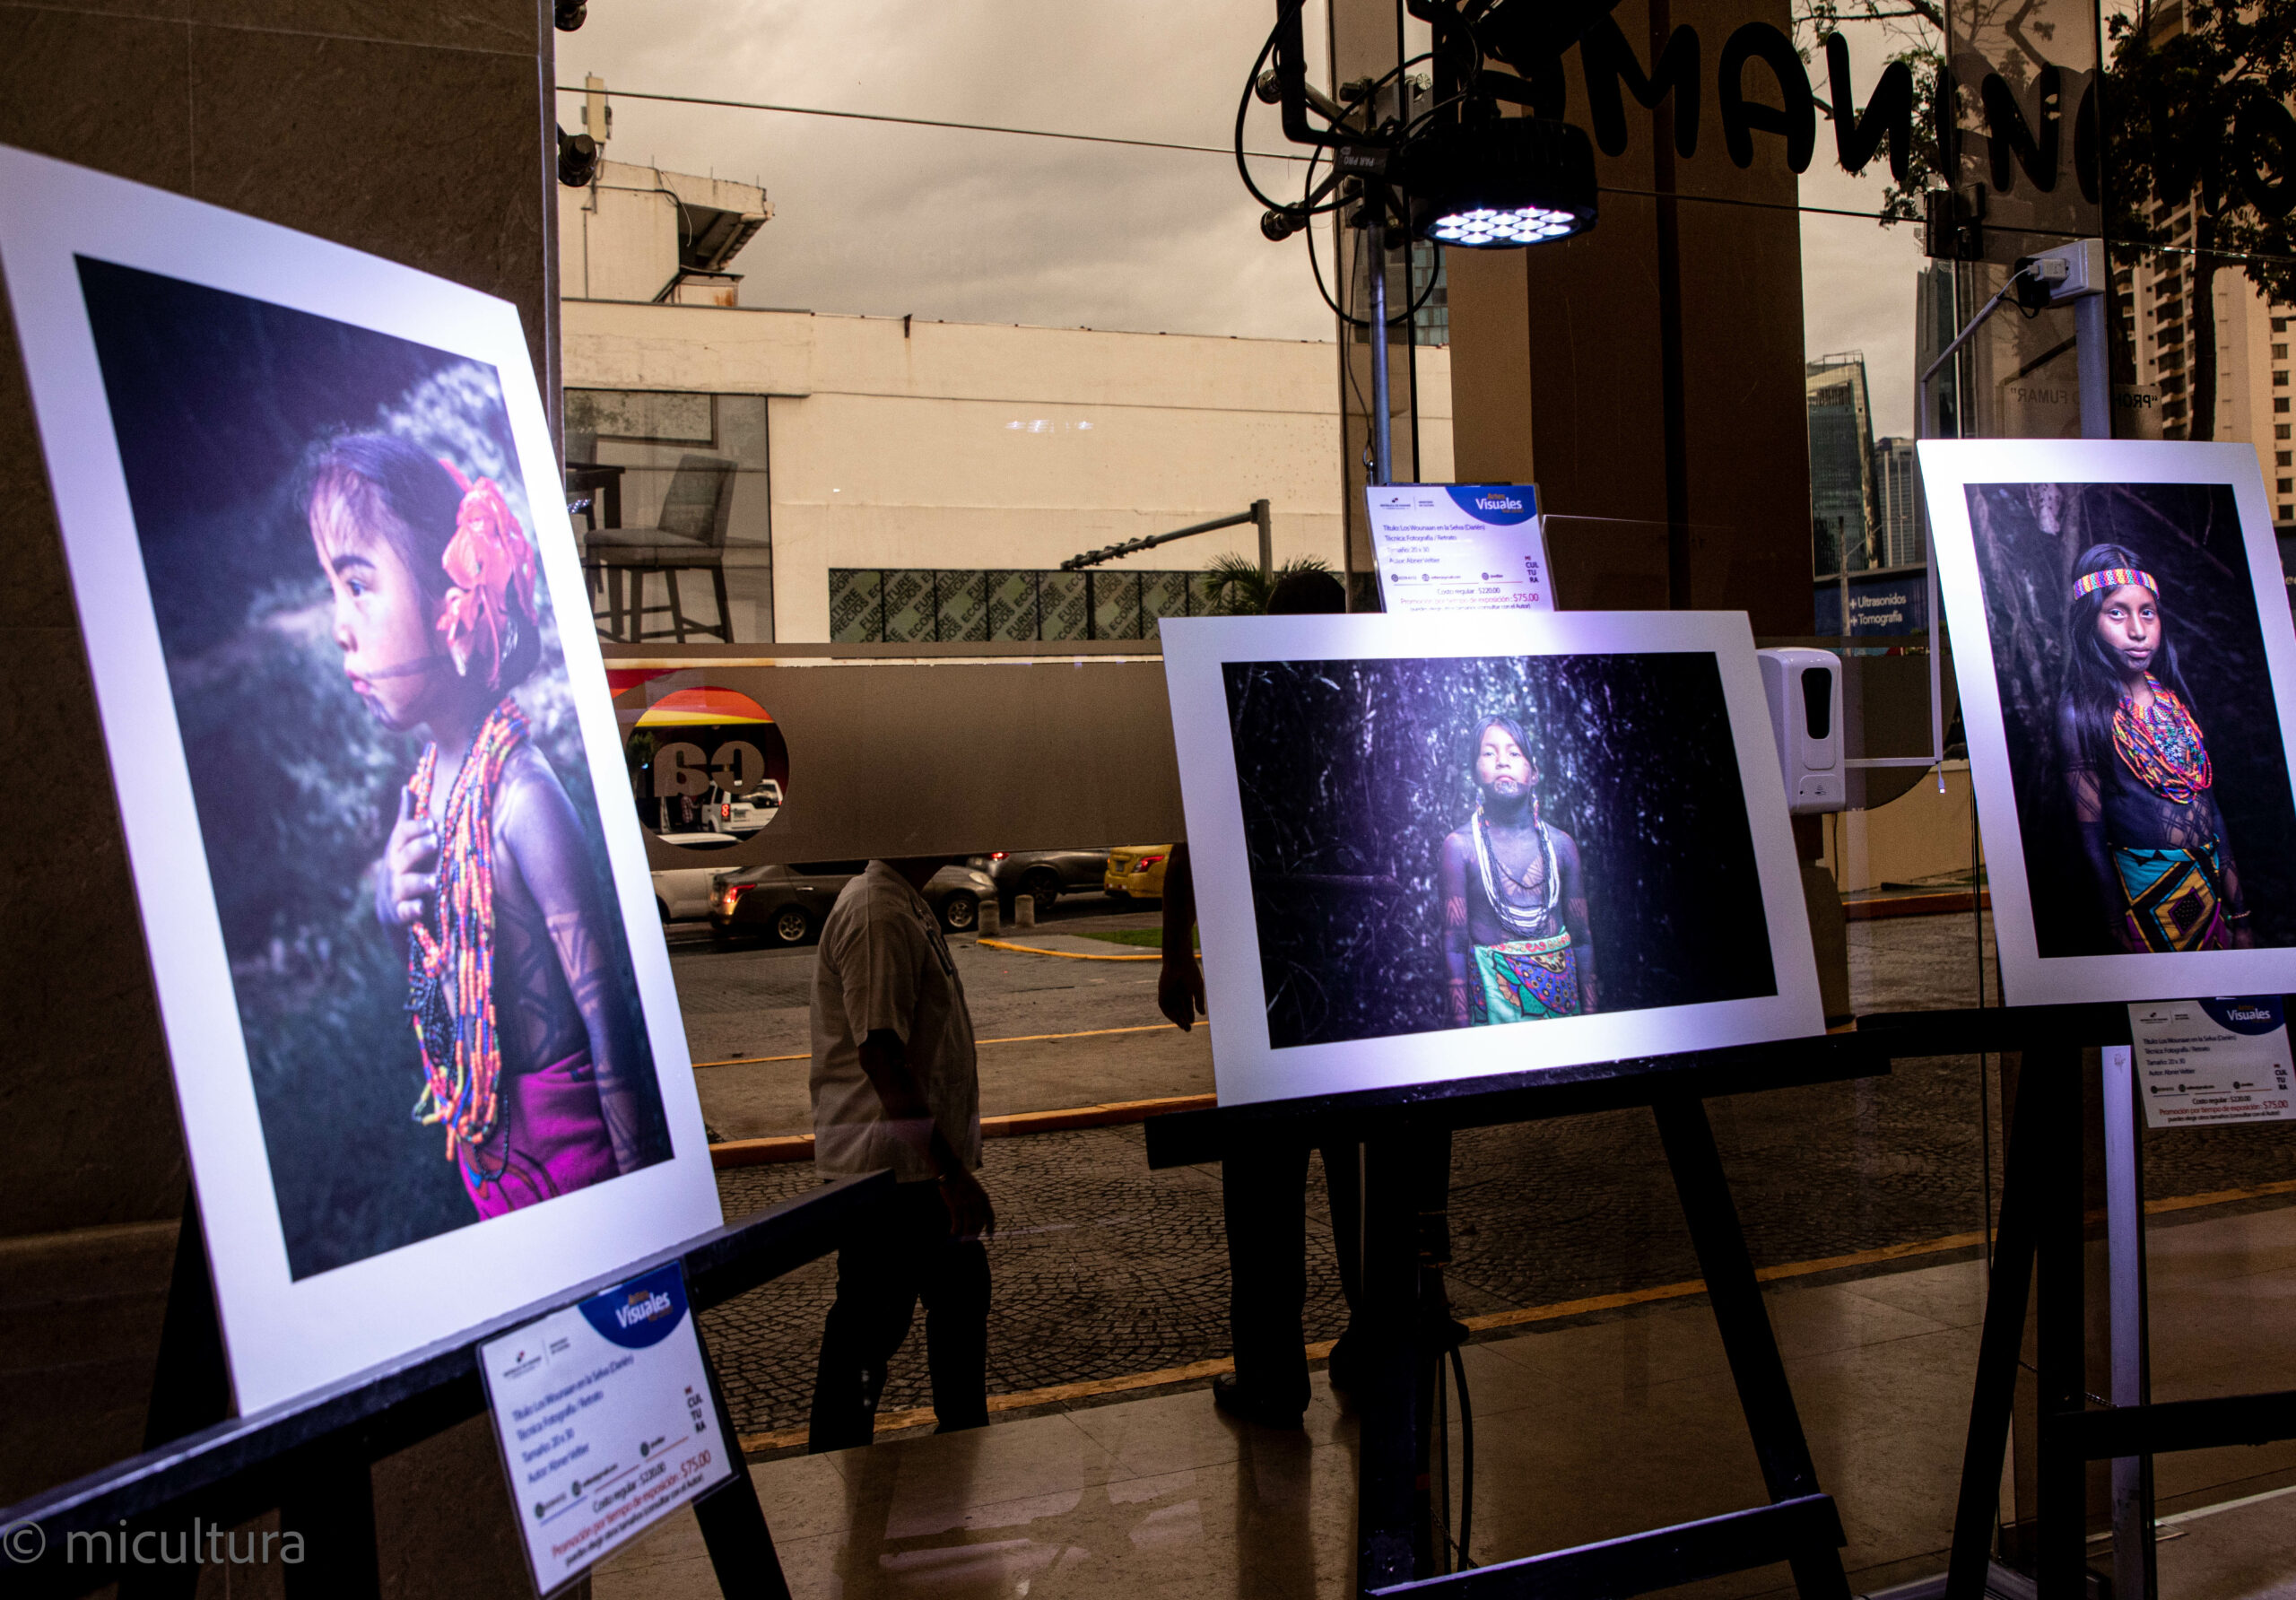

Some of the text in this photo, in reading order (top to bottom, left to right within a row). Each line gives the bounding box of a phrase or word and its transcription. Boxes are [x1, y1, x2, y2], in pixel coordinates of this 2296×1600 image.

[1475, 497, 1522, 509] Visuales
[1512, 592, 1539, 602] $75.00
[1857, 593, 1907, 608] Ultrasonidos
[1858, 610, 1903, 626] Tomografía
[2227, 1008, 2271, 1021] Visuales
[2263, 1100, 2289, 1109] $75.00
[615, 1292, 670, 1327] Visuales
[688, 1394, 702, 1408] CUL
[691, 1408, 701, 1421] TU
[681, 1449, 711, 1478] $75.00
